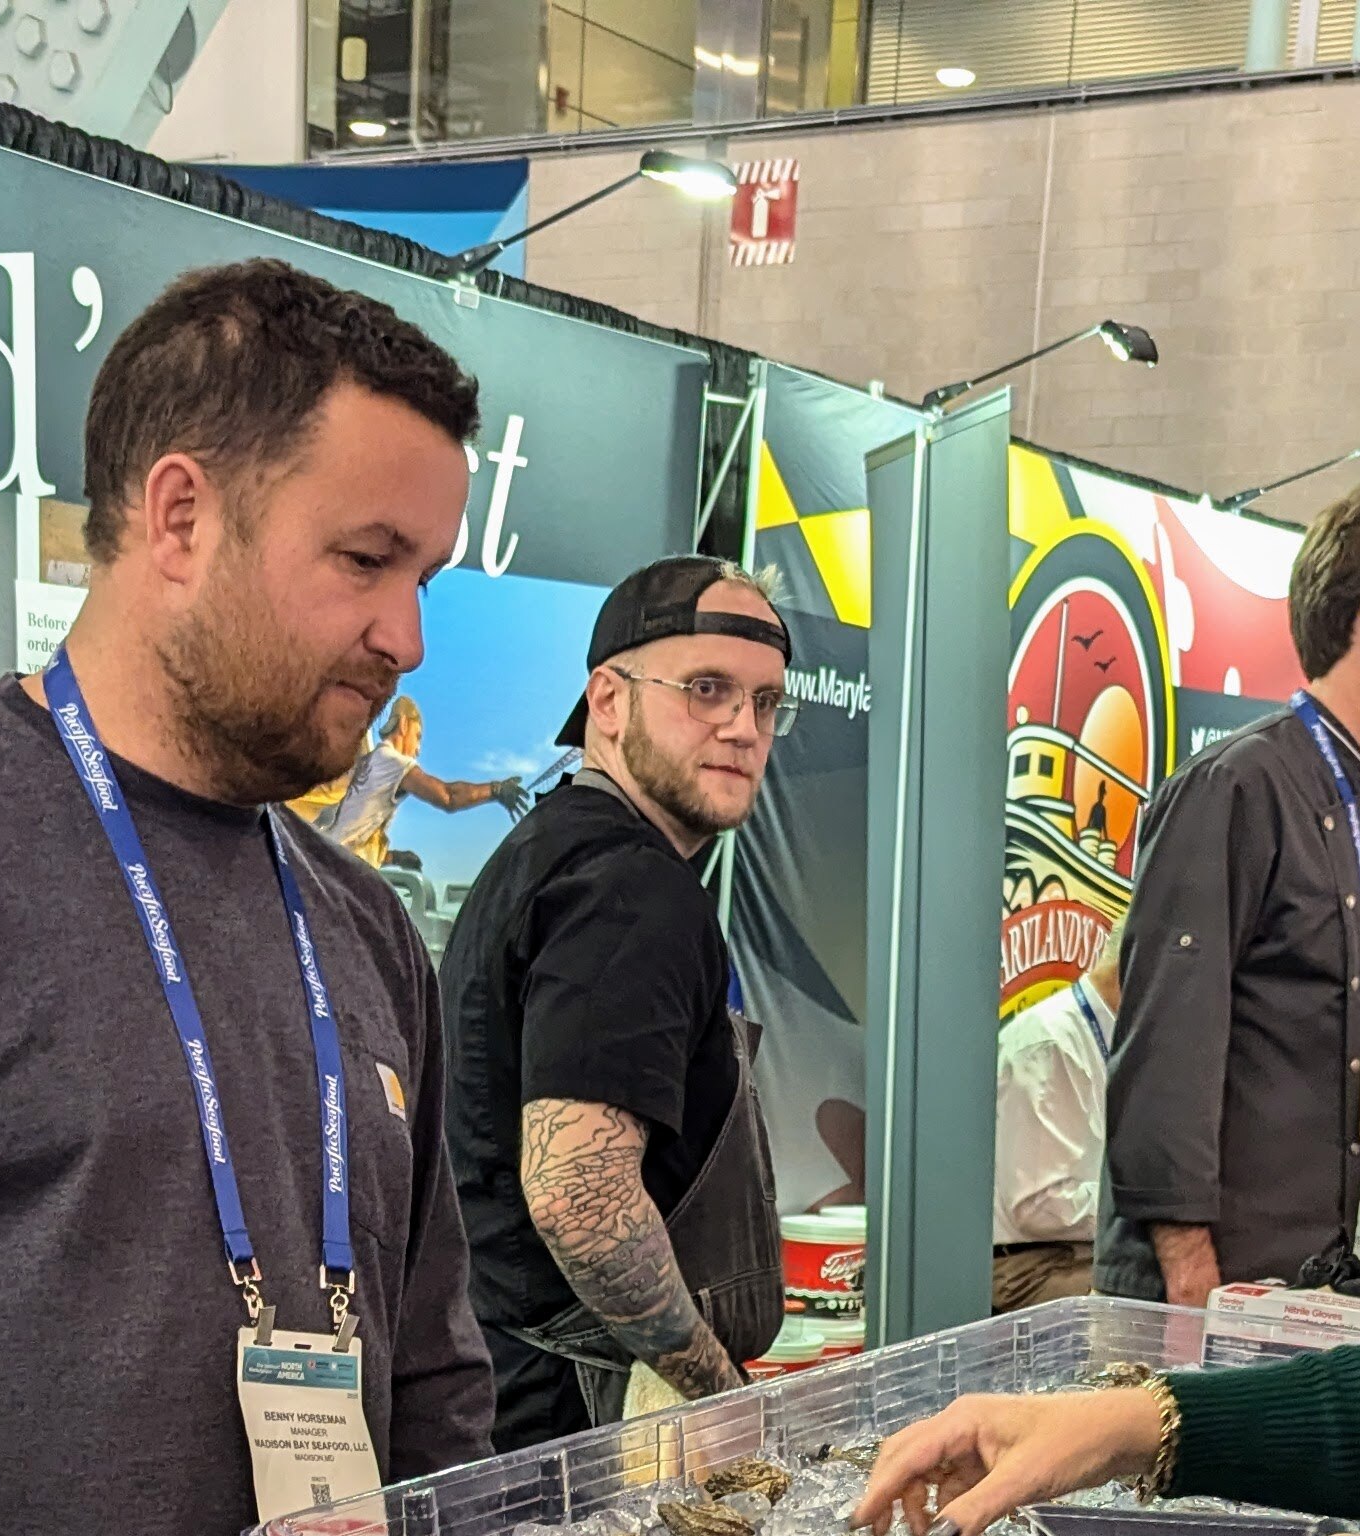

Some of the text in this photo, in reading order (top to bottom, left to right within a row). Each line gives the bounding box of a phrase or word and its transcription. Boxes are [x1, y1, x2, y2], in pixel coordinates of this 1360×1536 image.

[27, 612, 68, 632] Before
[1283, 1304, 1343, 1321] Nitrile Gloves
[264, 1411, 347, 1425] BENNY HORSEMAN
[293, 1440, 310, 1451] BAY
[353, 1442, 369, 1453] LLC
